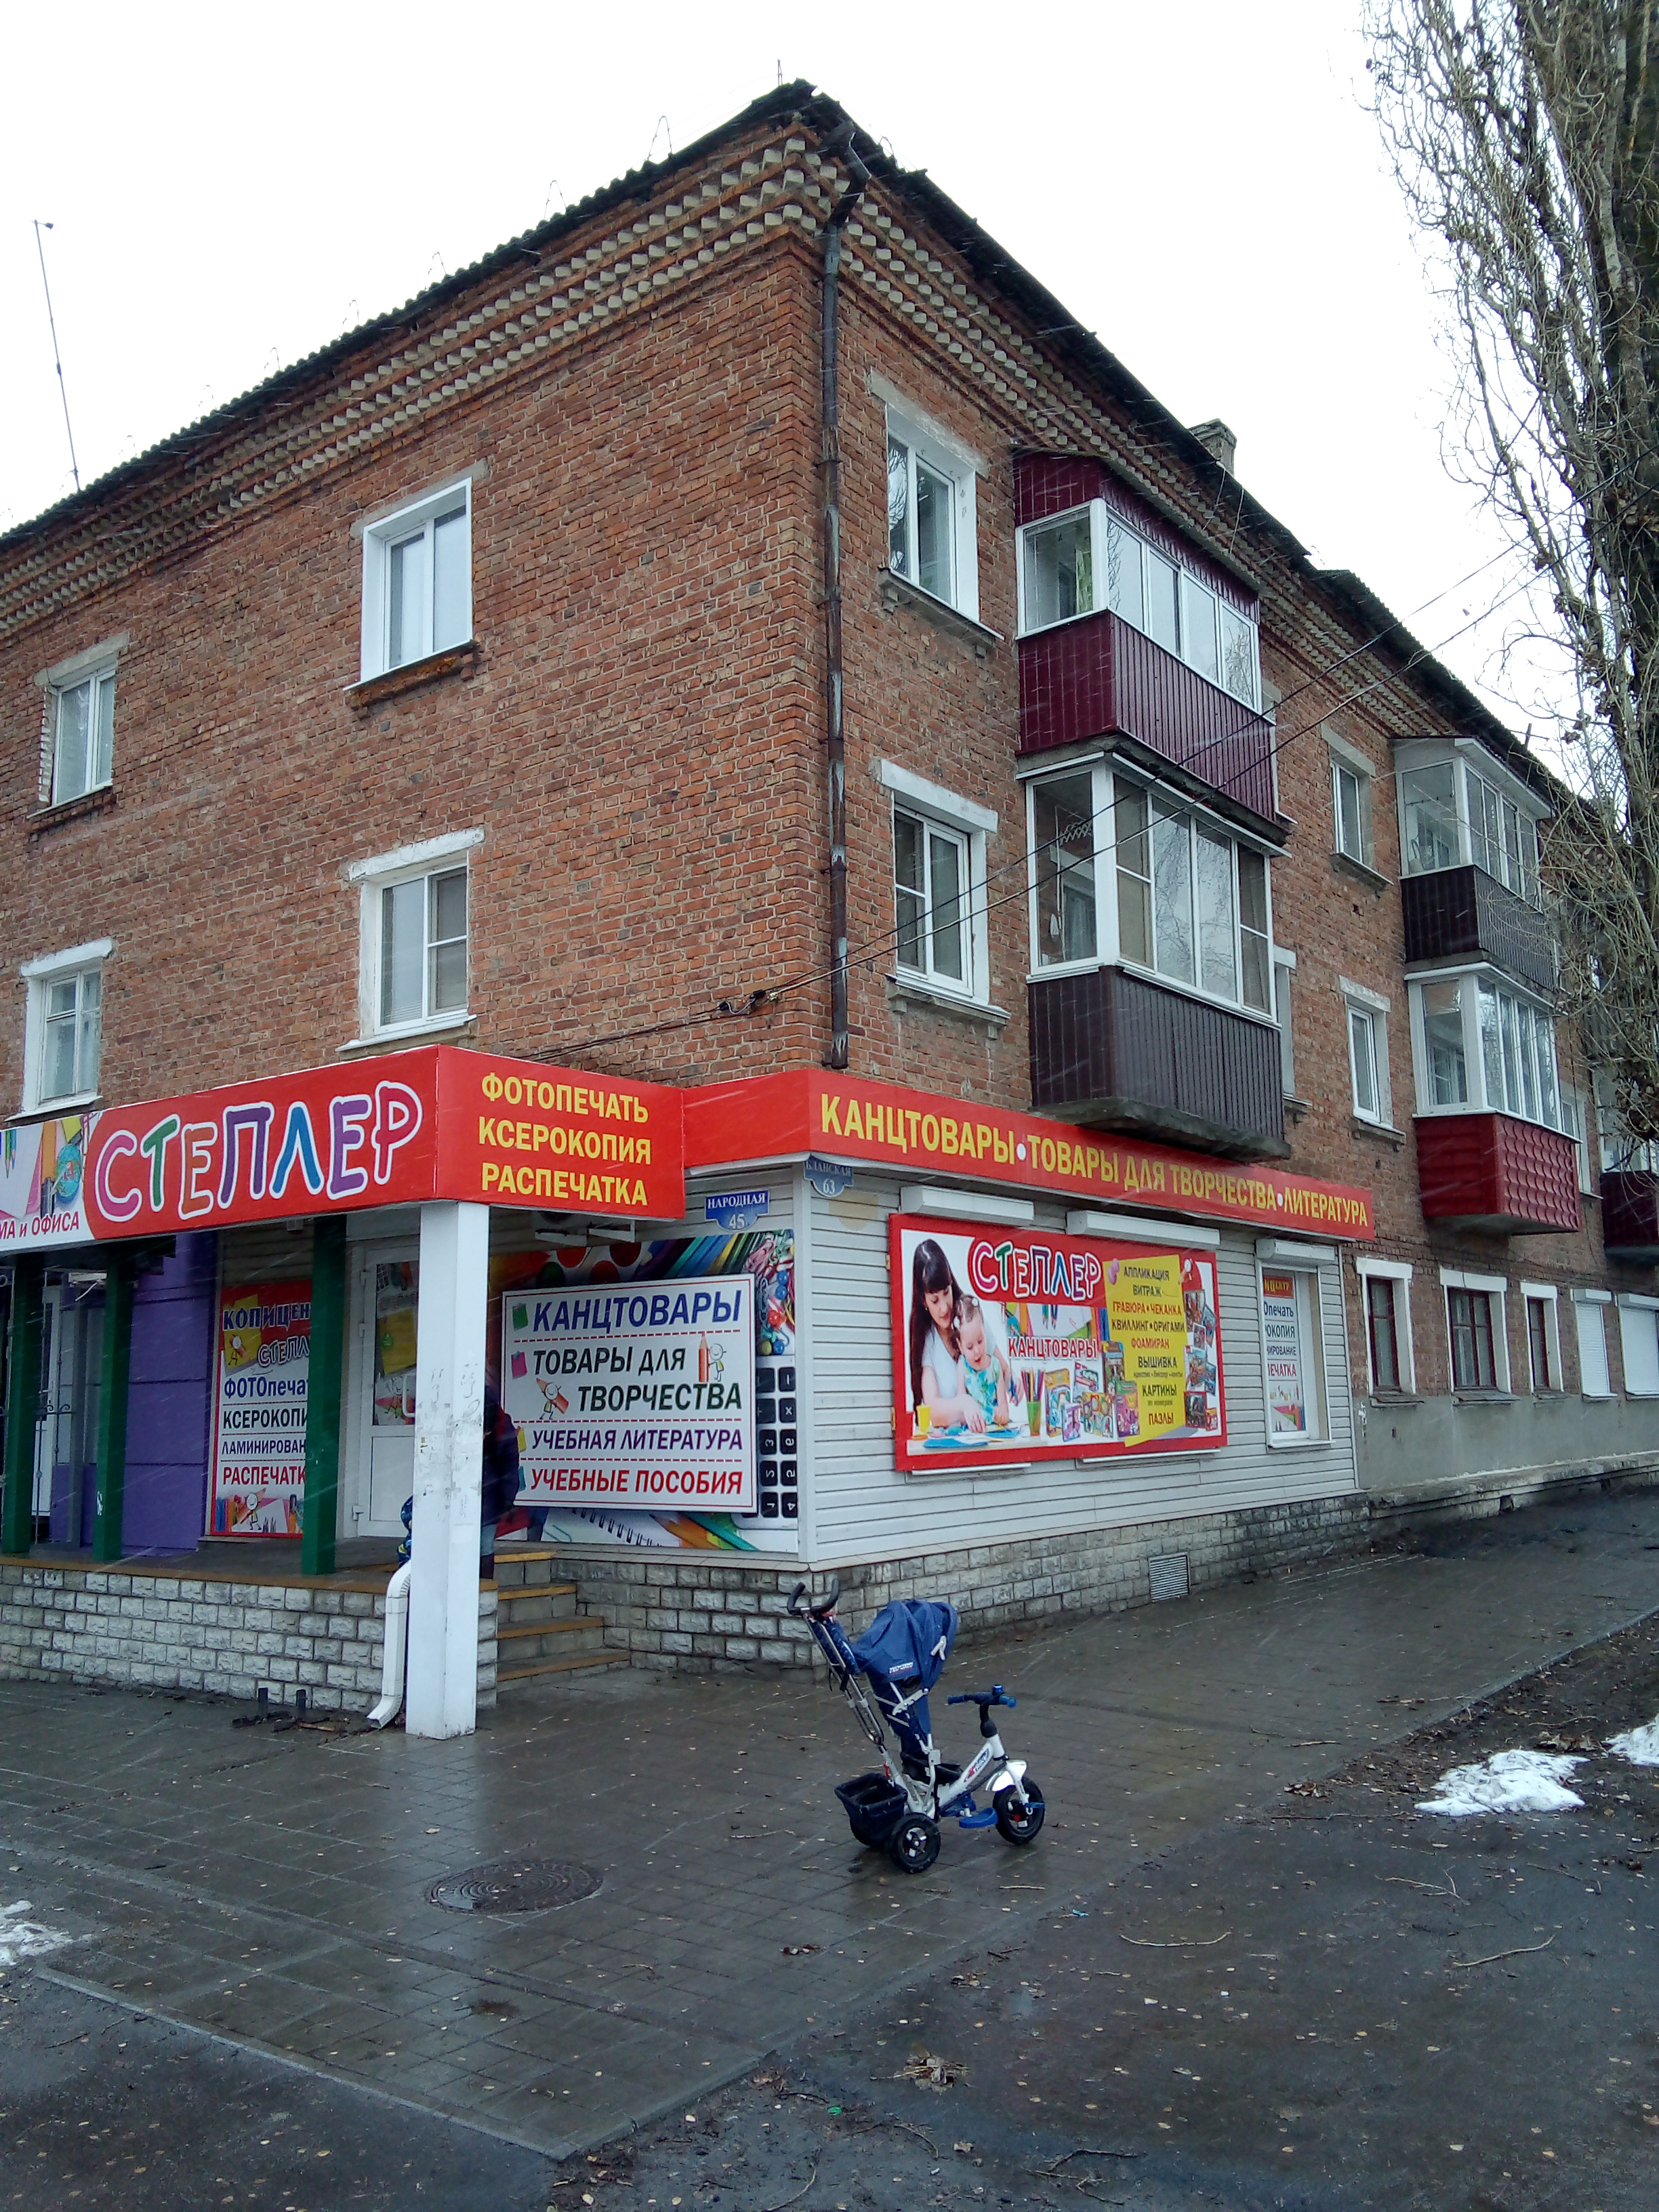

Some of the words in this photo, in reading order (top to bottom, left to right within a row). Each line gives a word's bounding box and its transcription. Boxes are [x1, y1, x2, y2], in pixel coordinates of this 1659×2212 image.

[481, 1071, 650, 1124] ФОТОПЕЧАТЬ
[94, 1081, 424, 1222] СТЕПЛЕР
[478, 1116, 652, 1165] КСЕРОКОПИЯ
[821, 1093, 1015, 1165] КАНЦТОВАРЫ
[1027, 1133, 1119, 1185] ТОВАРЫ
[1124, 1155, 1164, 1194] ДЛЯ
[1170, 1164, 1277, 1210] ТВОРЧЕСТВА
[1284, 1182, 1368, 1227] ЛИТЕРАТУРА
[481, 1162, 648, 1206] РАСПЕЧАТКА
[823, 1179, 835, 1194] 63
[707, 1193, 766, 1209] НАРОДНАЯ
[32, 1211, 79, 1235] ОФИСА
[729, 1214, 745, 1229] 45
[972, 1239, 1103, 1300] СТЕПЛЕР
[1124, 1267, 1170, 1282] АППЛИКАЦИЯ
[1133, 1284, 1162, 1297] ВИТРАЖ
[222, 1301, 312, 1332] КОПИЦЕН
[532, 1289, 742, 1334] КАНЦТОВАРЫ
[1113, 1301, 1146, 1314] ГРАВЮРА
[1150, 1303, 1182, 1315] ЧЕКАНКА
[1263, 1300, 1294, 1317] Опечать
[1111, 1319, 1149, 1331] КВИЛЛИНГ
[1153, 1321, 1186, 1333] ОРИГАМИ
[258, 1335, 310, 1368] СТЕПЛ
[1008, 1337, 1097, 1362] КАНЦТОВАРЫ
[1131, 1337, 1170, 1349] ФОАМИРАН
[533, 1346, 632, 1376] ТОВАРЫ
[1138, 1356, 1178, 1368] ВЫШИВКА
[224, 1376, 308, 1399] ФОТОпеча
[577, 1382, 742, 1413] ТВОРЧЕСТВА
[1142, 1384, 1177, 1397] КАРТИНЫ
[223, 1408, 307, 1429] КСЕРОКОПИ
[1149, 1412, 1174, 1425] ПАЗЛЫ
[222, 1439, 306, 1455] ЛАМИНИРОВАН
[532, 1428, 615, 1450] УЧЕБНАЯ
[620, 1428, 743, 1450] ЛИТЕРАТУРА
[222, 1465, 306, 1485] РАСПЕЧАТК
[531, 1469, 630, 1492] УЧЕБНЫЕ
[635, 1471, 742, 1495] ПОСОБИЯ
